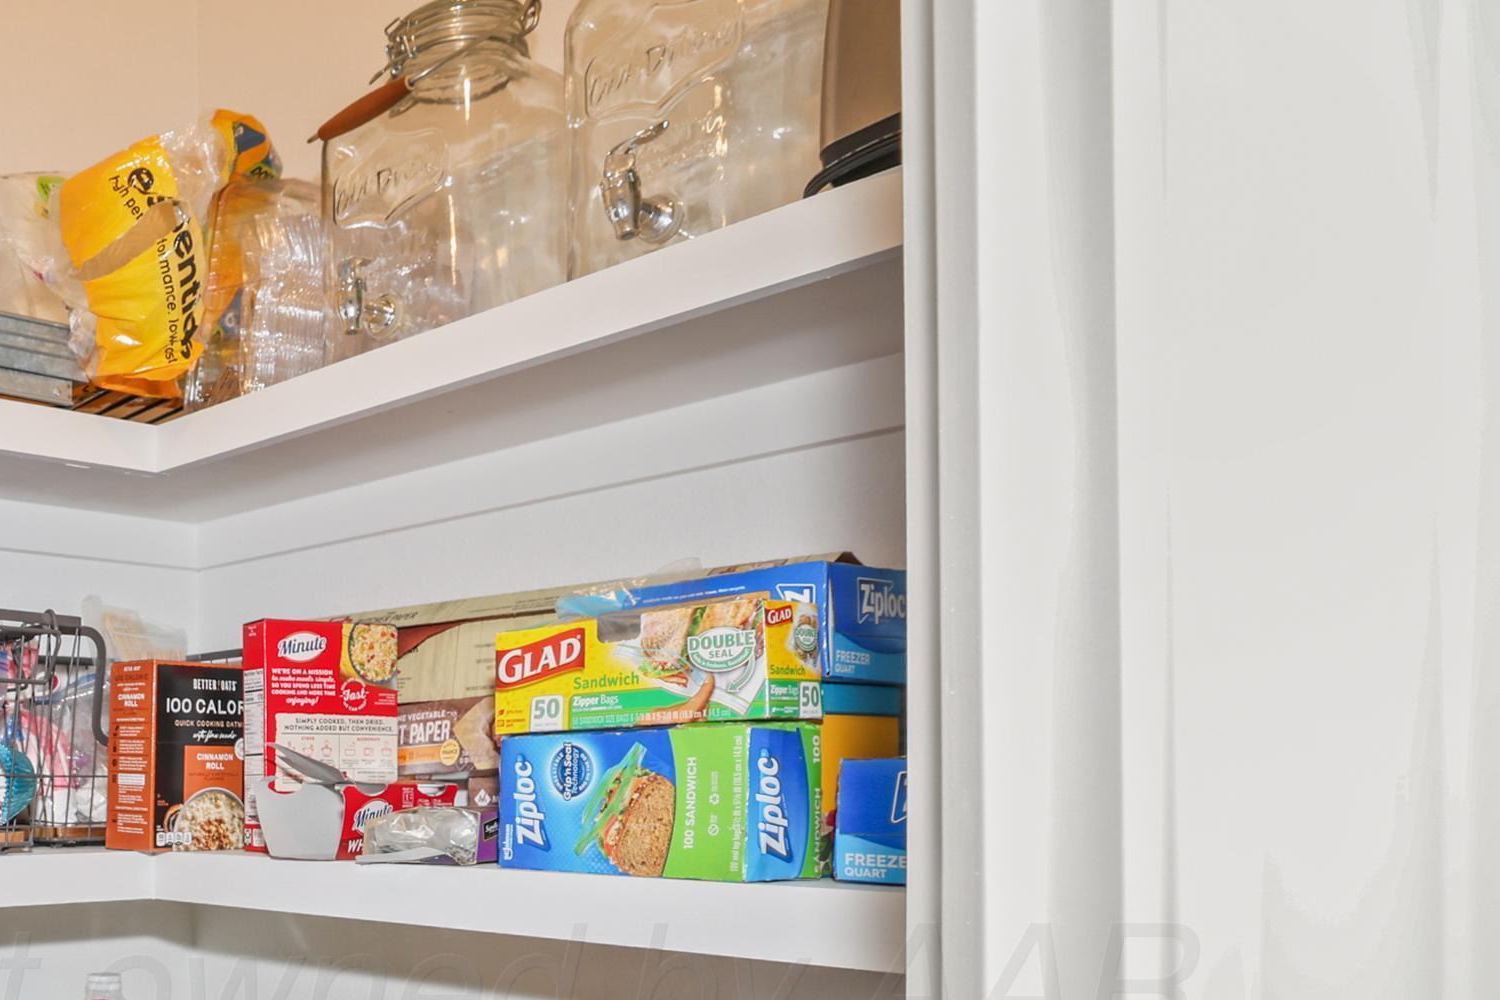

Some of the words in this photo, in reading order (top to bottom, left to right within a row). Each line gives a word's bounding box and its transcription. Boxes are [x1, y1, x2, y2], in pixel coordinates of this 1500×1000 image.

[860, 583, 907, 624] Ziploc
[767, 609, 792, 624] GLAD
[279, 636, 326, 656] Minute
[688, 631, 755, 651] DOUBLE
[498, 642, 581, 684] GLAD
[708, 650, 734, 659] SEAL
[835, 650, 870, 664] FREEZER
[769, 665, 806, 675] Sandwich
[573, 672, 640, 690] Sandwich
[166, 697, 192, 713] 100
[195, 698, 244, 715] CALOR
[572, 695, 600, 707] Zipper
[600, 694, 619, 706] Bags
[801, 686, 820, 708] 50
[408, 710, 446, 721] VEGETABLE
[533, 697, 560, 720] 50
[174, 719, 195, 727] QUICK
[196, 719, 224, 728] COOKING
[409, 719, 450, 745] PAPER
[196, 753, 234, 761] CINNAMON
[205, 762, 225, 770] ROLL
[571, 748, 580, 794] Technology
[685, 756, 697, 827] SANDWICH
[513, 759, 545, 846] Ziploc
[755, 756, 789, 856] Ziploc
[684, 829, 695, 849] 100
[844, 852, 907, 869] FREEZE
[844, 866, 888, 878] QUART
